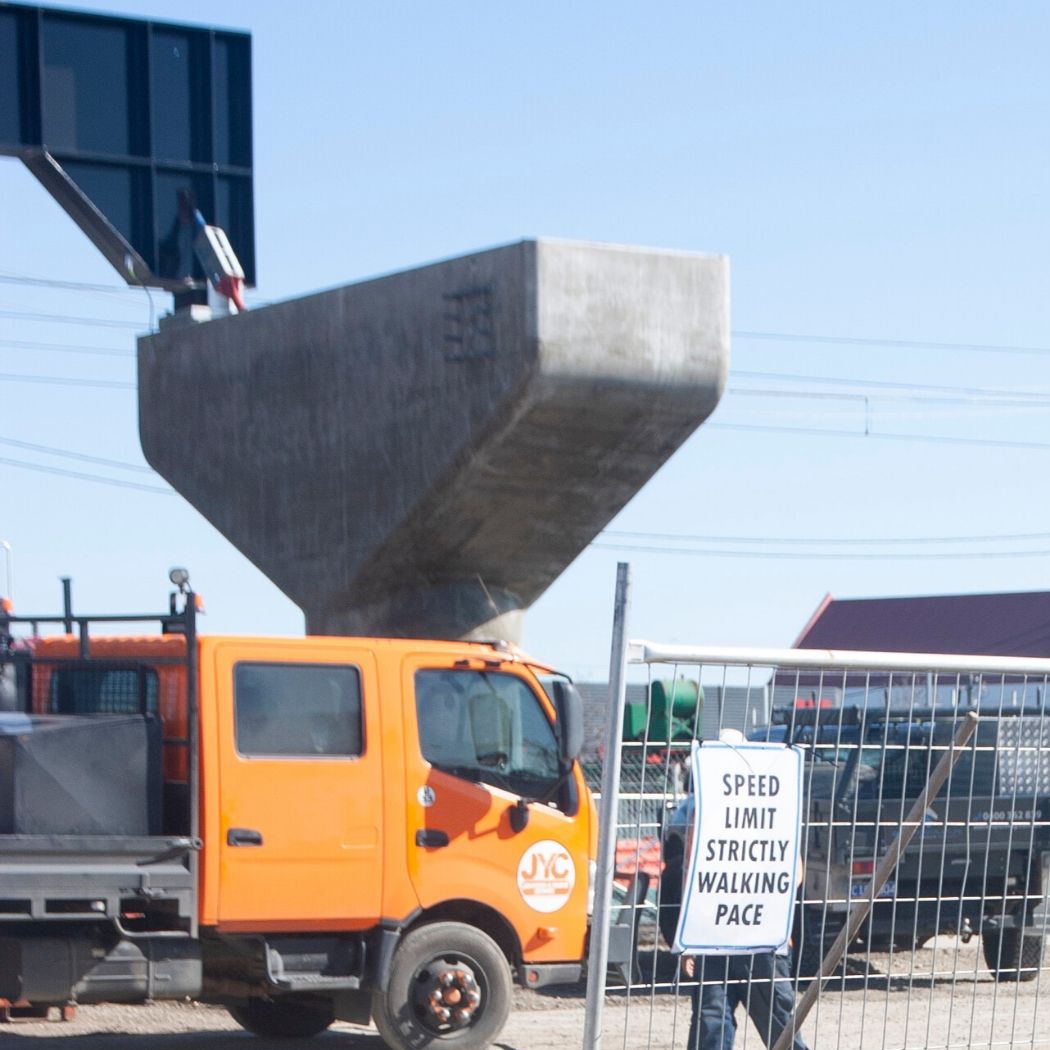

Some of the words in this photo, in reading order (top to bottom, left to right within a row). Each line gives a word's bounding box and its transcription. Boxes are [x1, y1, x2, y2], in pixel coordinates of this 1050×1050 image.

[723, 773, 780, 797] SPEED
[725, 806, 777, 829] LIMIT
[705, 839, 789, 862] STRICTLY
[521, 853, 568, 879] JYC
[698, 872, 790, 894] WALKING
[715, 904, 764, 926] PACE
